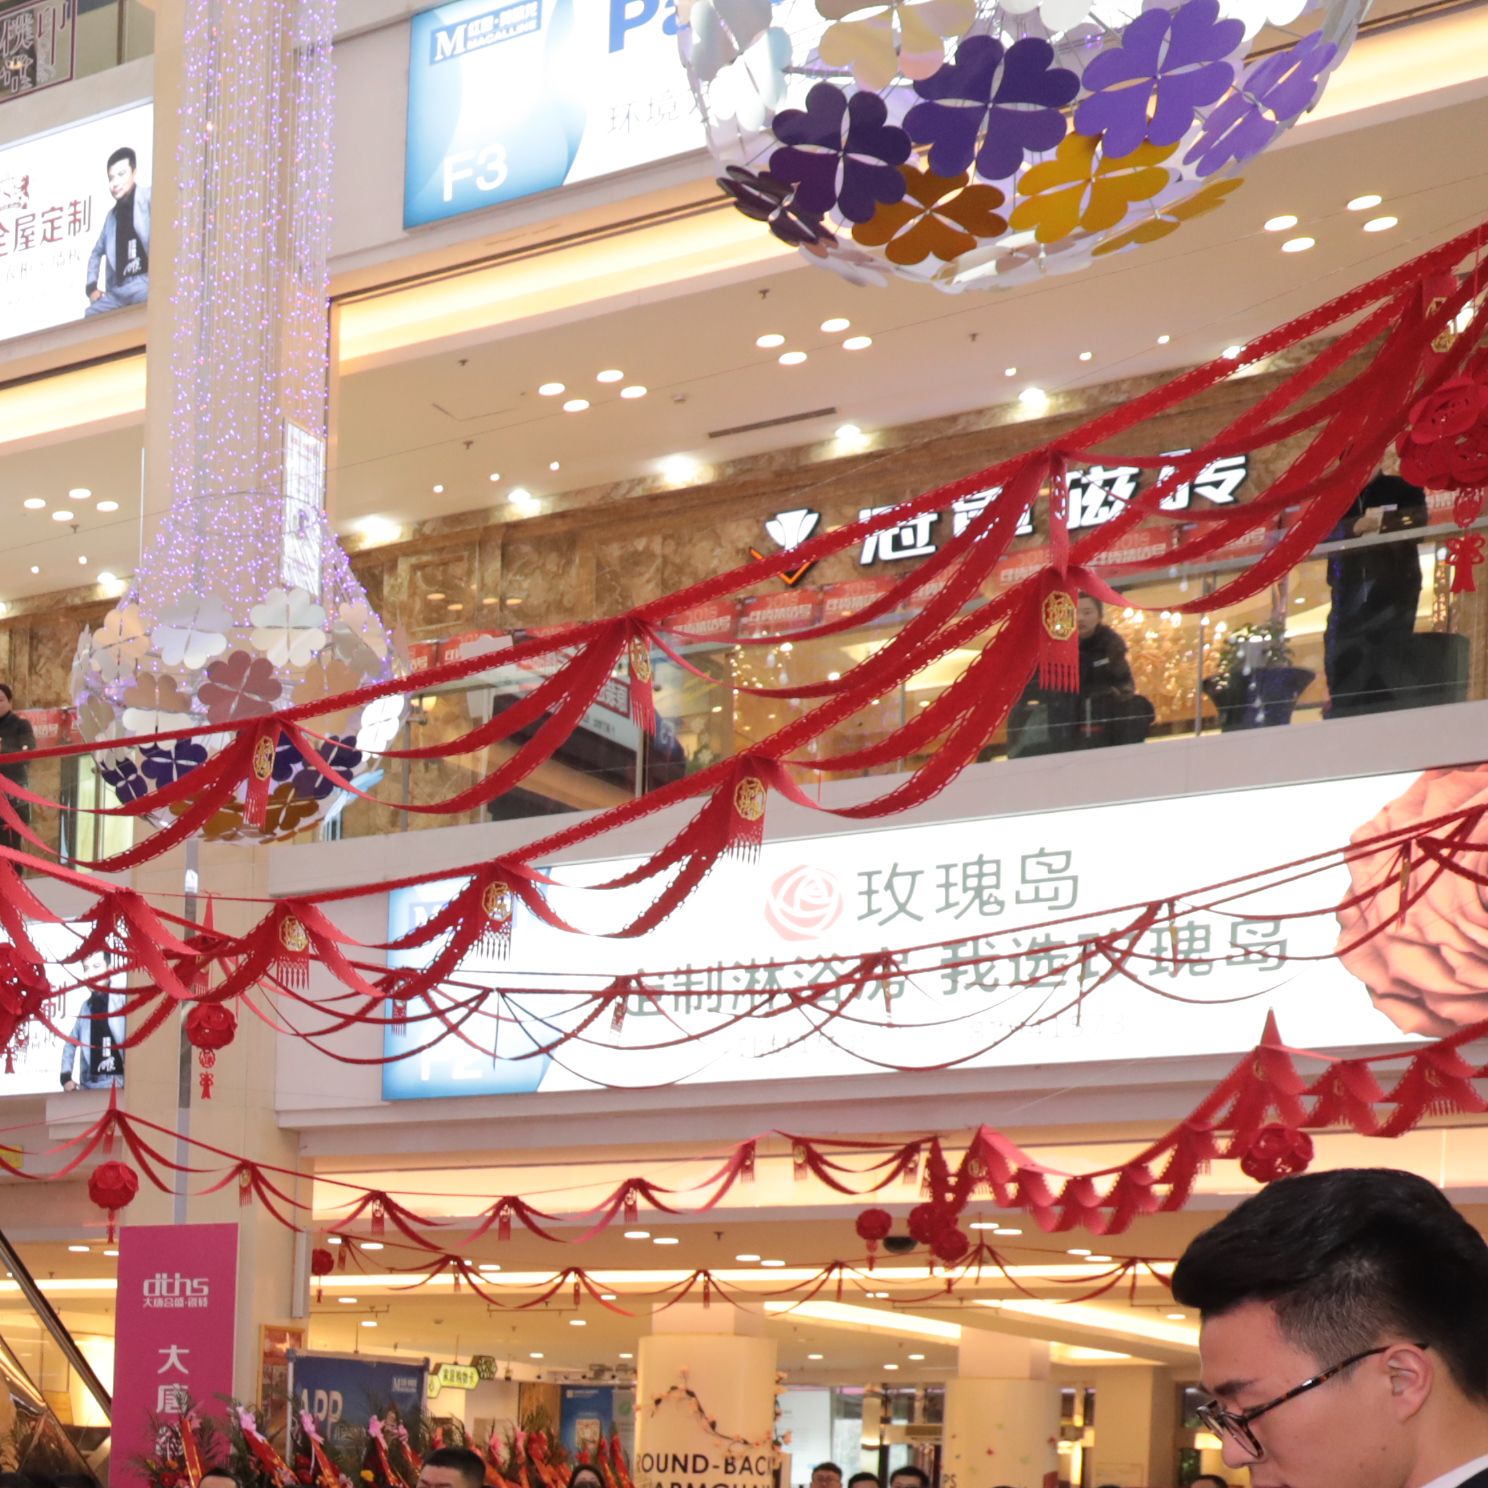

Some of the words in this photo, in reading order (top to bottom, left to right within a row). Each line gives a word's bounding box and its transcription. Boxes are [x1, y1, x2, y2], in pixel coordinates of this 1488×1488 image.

[434, 24, 469, 62] M
[608, 88, 707, 136] 环境
[443, 143, 508, 202] F3
[856, 847, 1080, 929] 玫瑰岛
[155, 1343, 190, 1459] 大唐
[299, 1388, 344, 1433] APP
